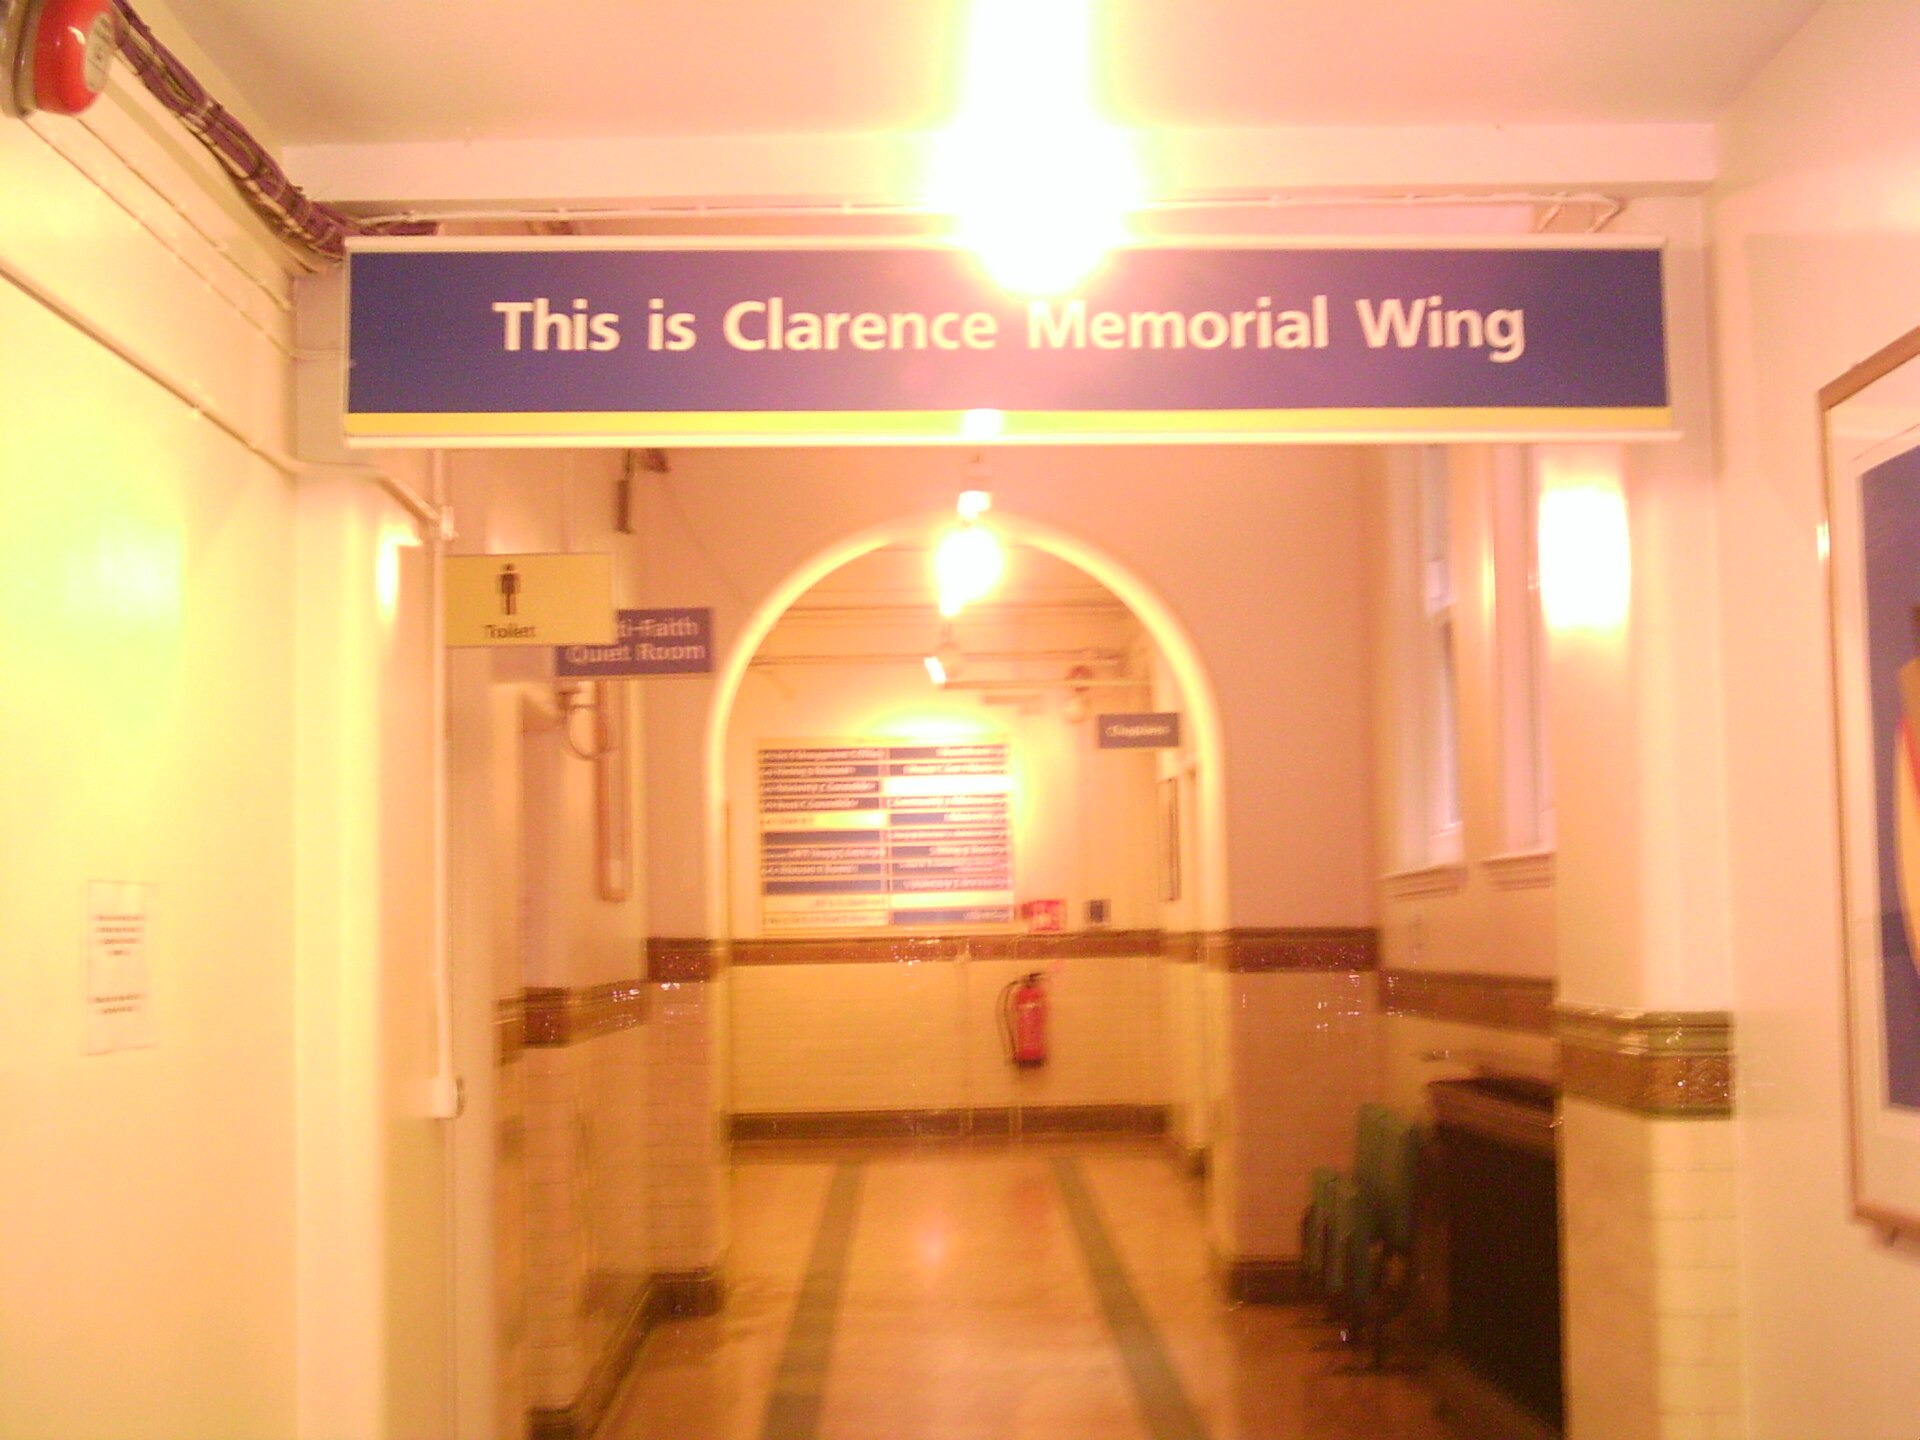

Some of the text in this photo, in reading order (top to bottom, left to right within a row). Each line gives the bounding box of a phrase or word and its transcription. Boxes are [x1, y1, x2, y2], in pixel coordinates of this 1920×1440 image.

[492, 294, 1526, 364] This is Clarence Memorial Wing
[482, 623, 537, 639] Toilet
[565, 643, 707, 665] Quiet Room
